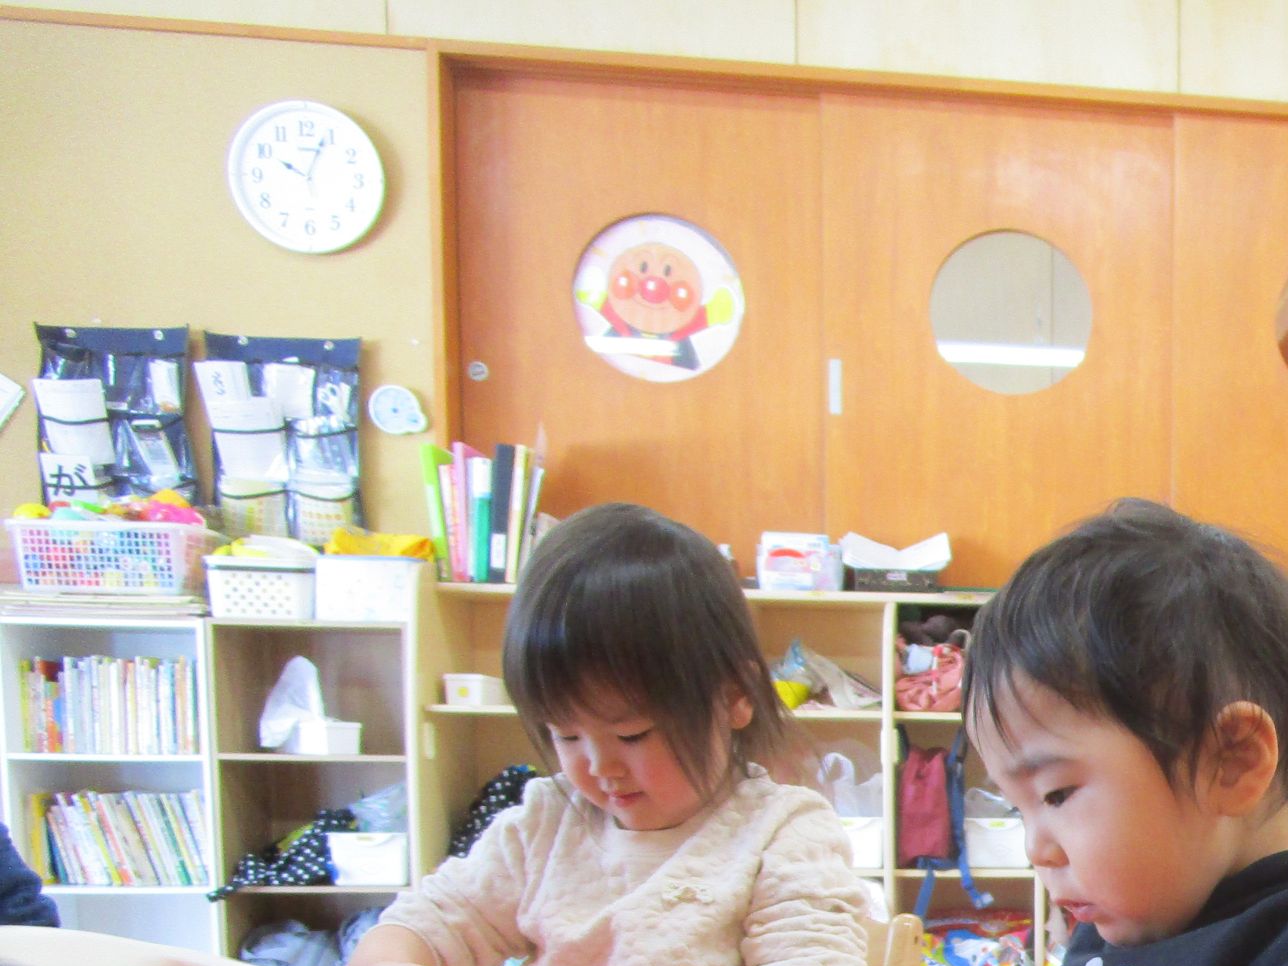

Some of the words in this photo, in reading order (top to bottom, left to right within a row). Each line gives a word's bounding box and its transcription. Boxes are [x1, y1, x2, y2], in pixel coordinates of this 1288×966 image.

[275, 125, 287, 142] 11
[298, 120, 315, 137] 12
[328, 128, 336, 145] 1
[257, 143, 273, 159] 10
[345, 148, 357, 165] 2
[252, 167, 264, 183] 9
[353, 173, 364, 190] 3
[259, 192, 271, 209] 8
[345, 197, 356, 213] 4
[278, 212, 290, 227] 7
[304, 219, 316, 235] 6
[329, 215, 341, 231] 5
[50, 464, 87, 497] が
